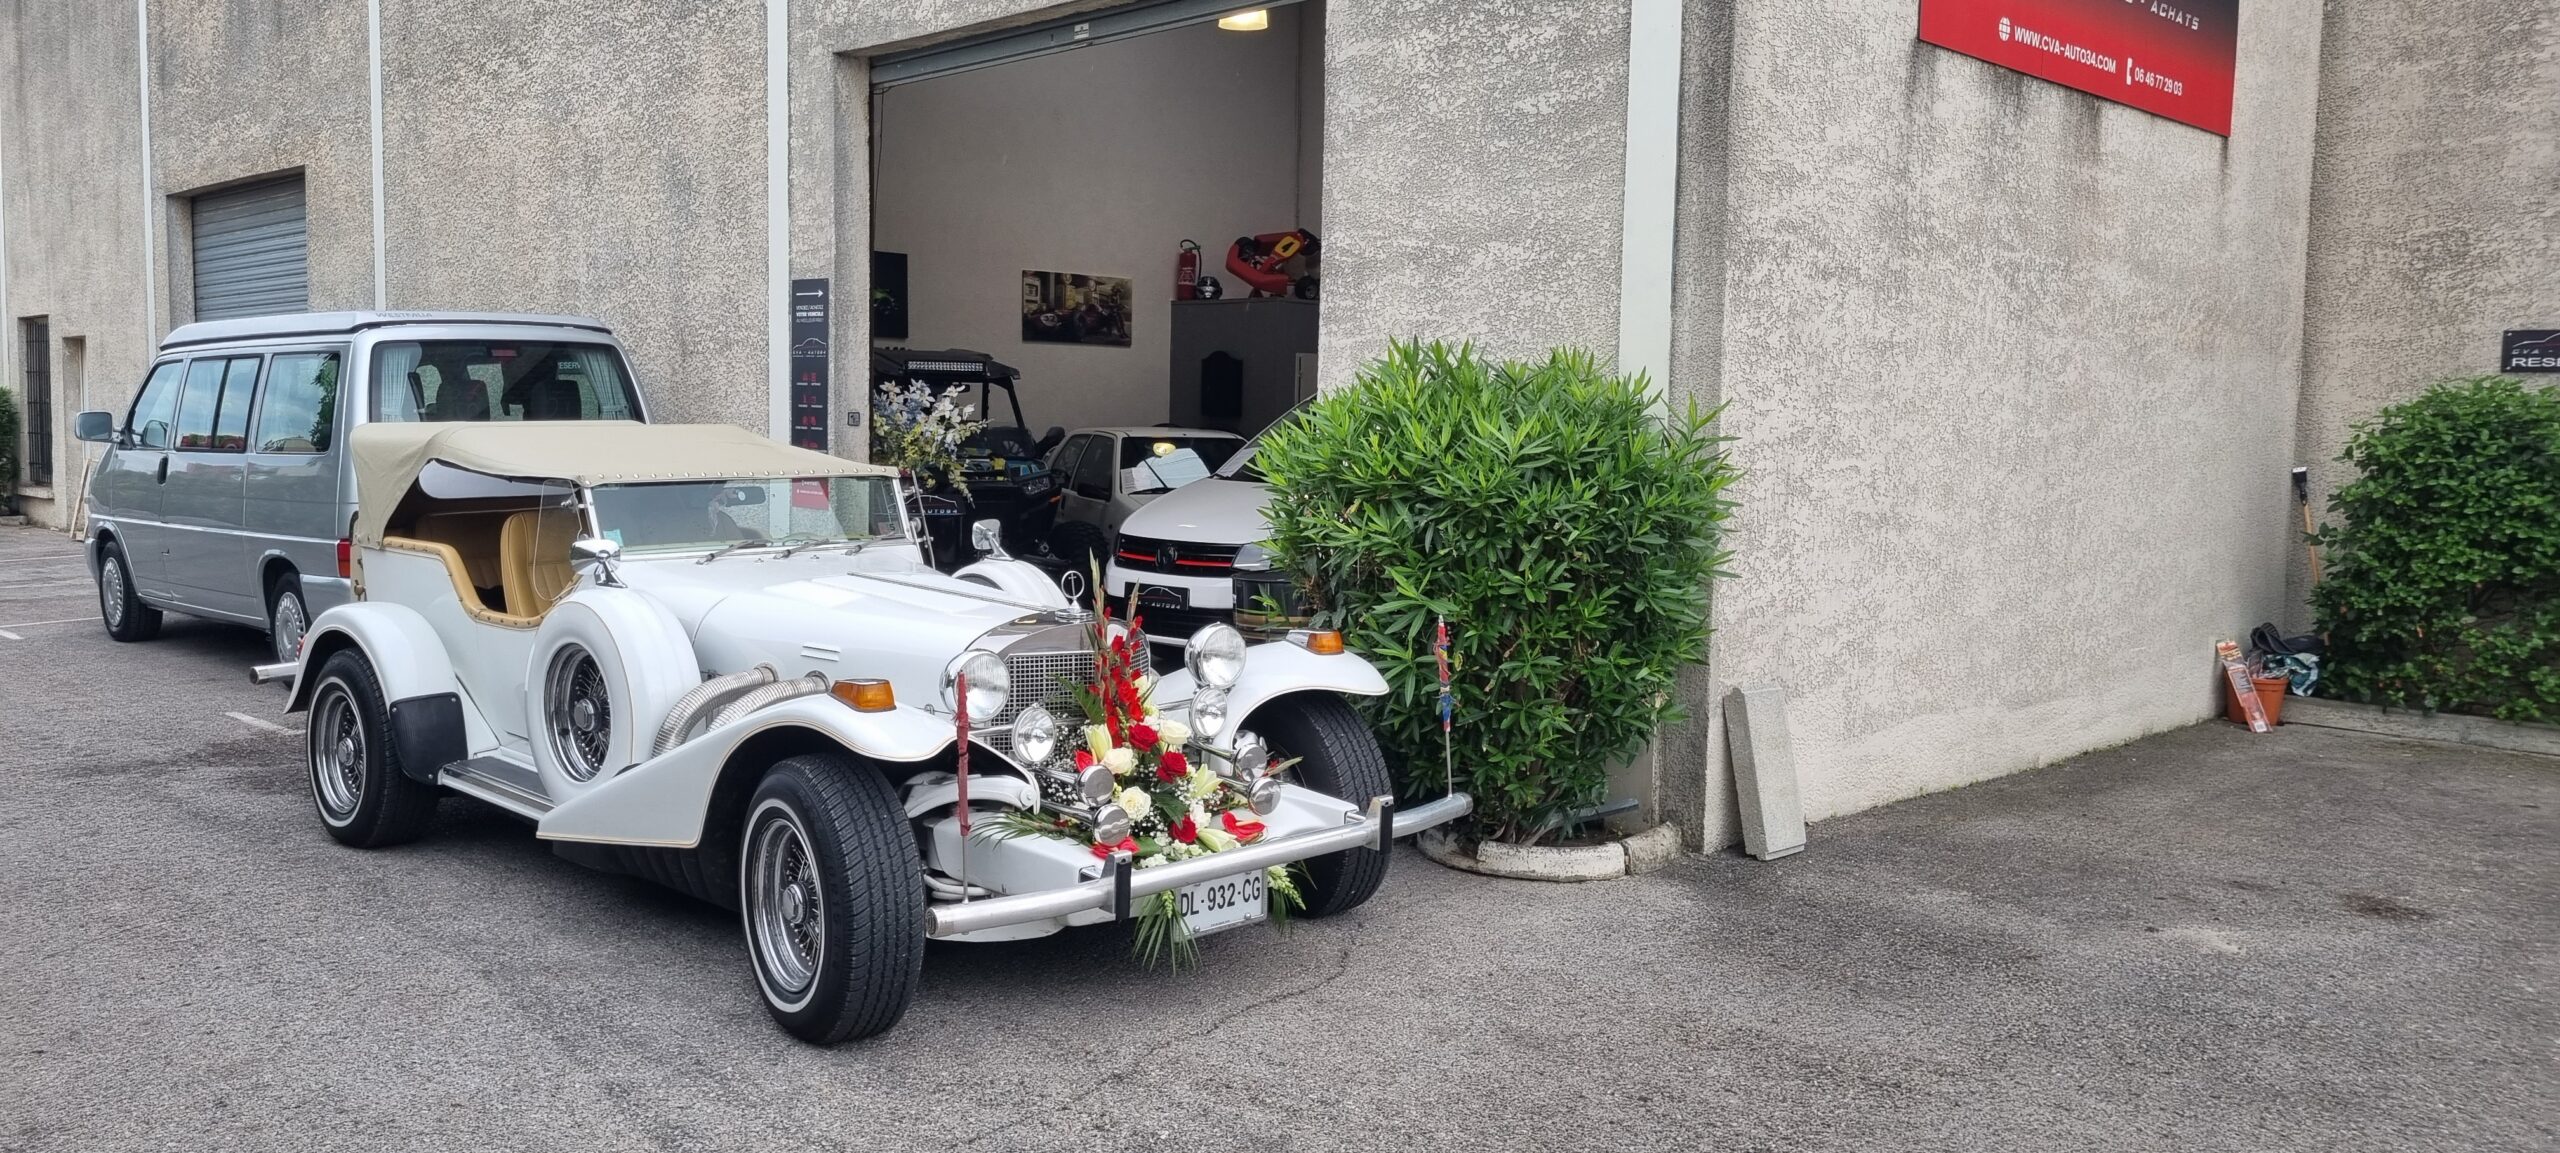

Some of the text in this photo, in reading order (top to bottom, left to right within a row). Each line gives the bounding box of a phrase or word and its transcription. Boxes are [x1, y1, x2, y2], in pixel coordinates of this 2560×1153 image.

[2150, 0, 2200, 31] ACHATS
[2014, 25, 2117, 74] WWW.CVA-AUTO34.COM
[2134, 67, 2183, 97] 06 46 77 29 03
[1281, 241, 1294, 253] 4
[1180, 876, 1261, 917] DL-932-CG
